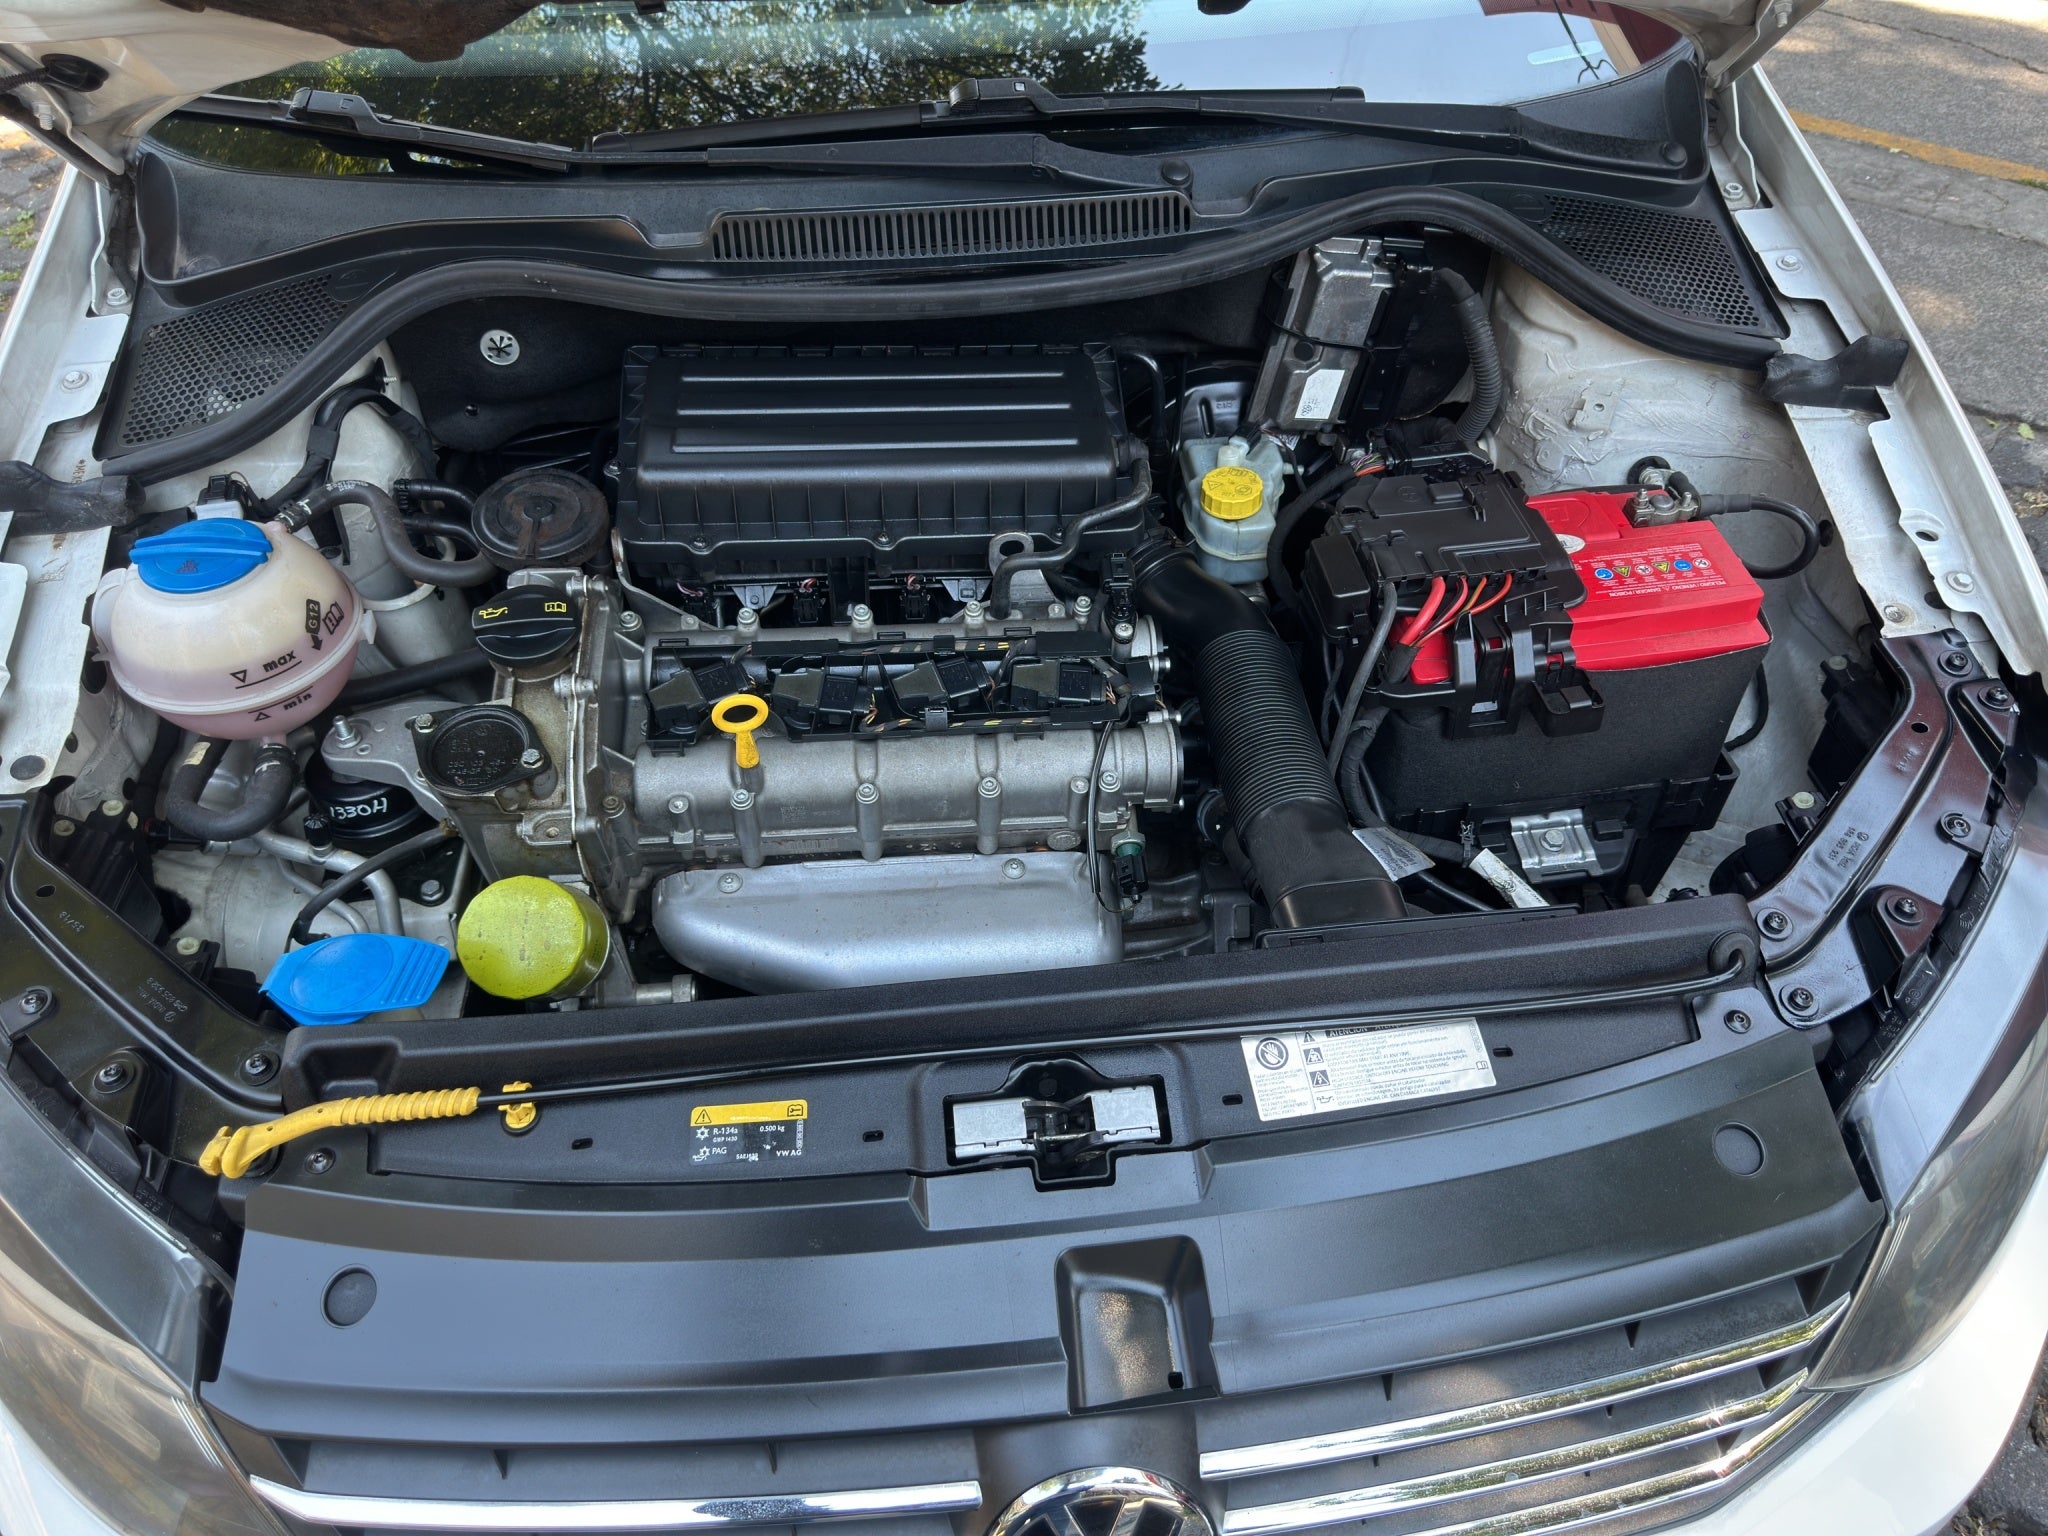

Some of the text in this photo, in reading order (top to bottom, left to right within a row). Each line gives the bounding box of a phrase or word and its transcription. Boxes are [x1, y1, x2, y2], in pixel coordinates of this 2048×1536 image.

[308, 603, 319, 629] G12
[262, 650, 297, 673] max
[283, 692, 312, 710] min
[329, 797, 388, 820] 1330H
[713, 1127, 738, 1135] R-134a
